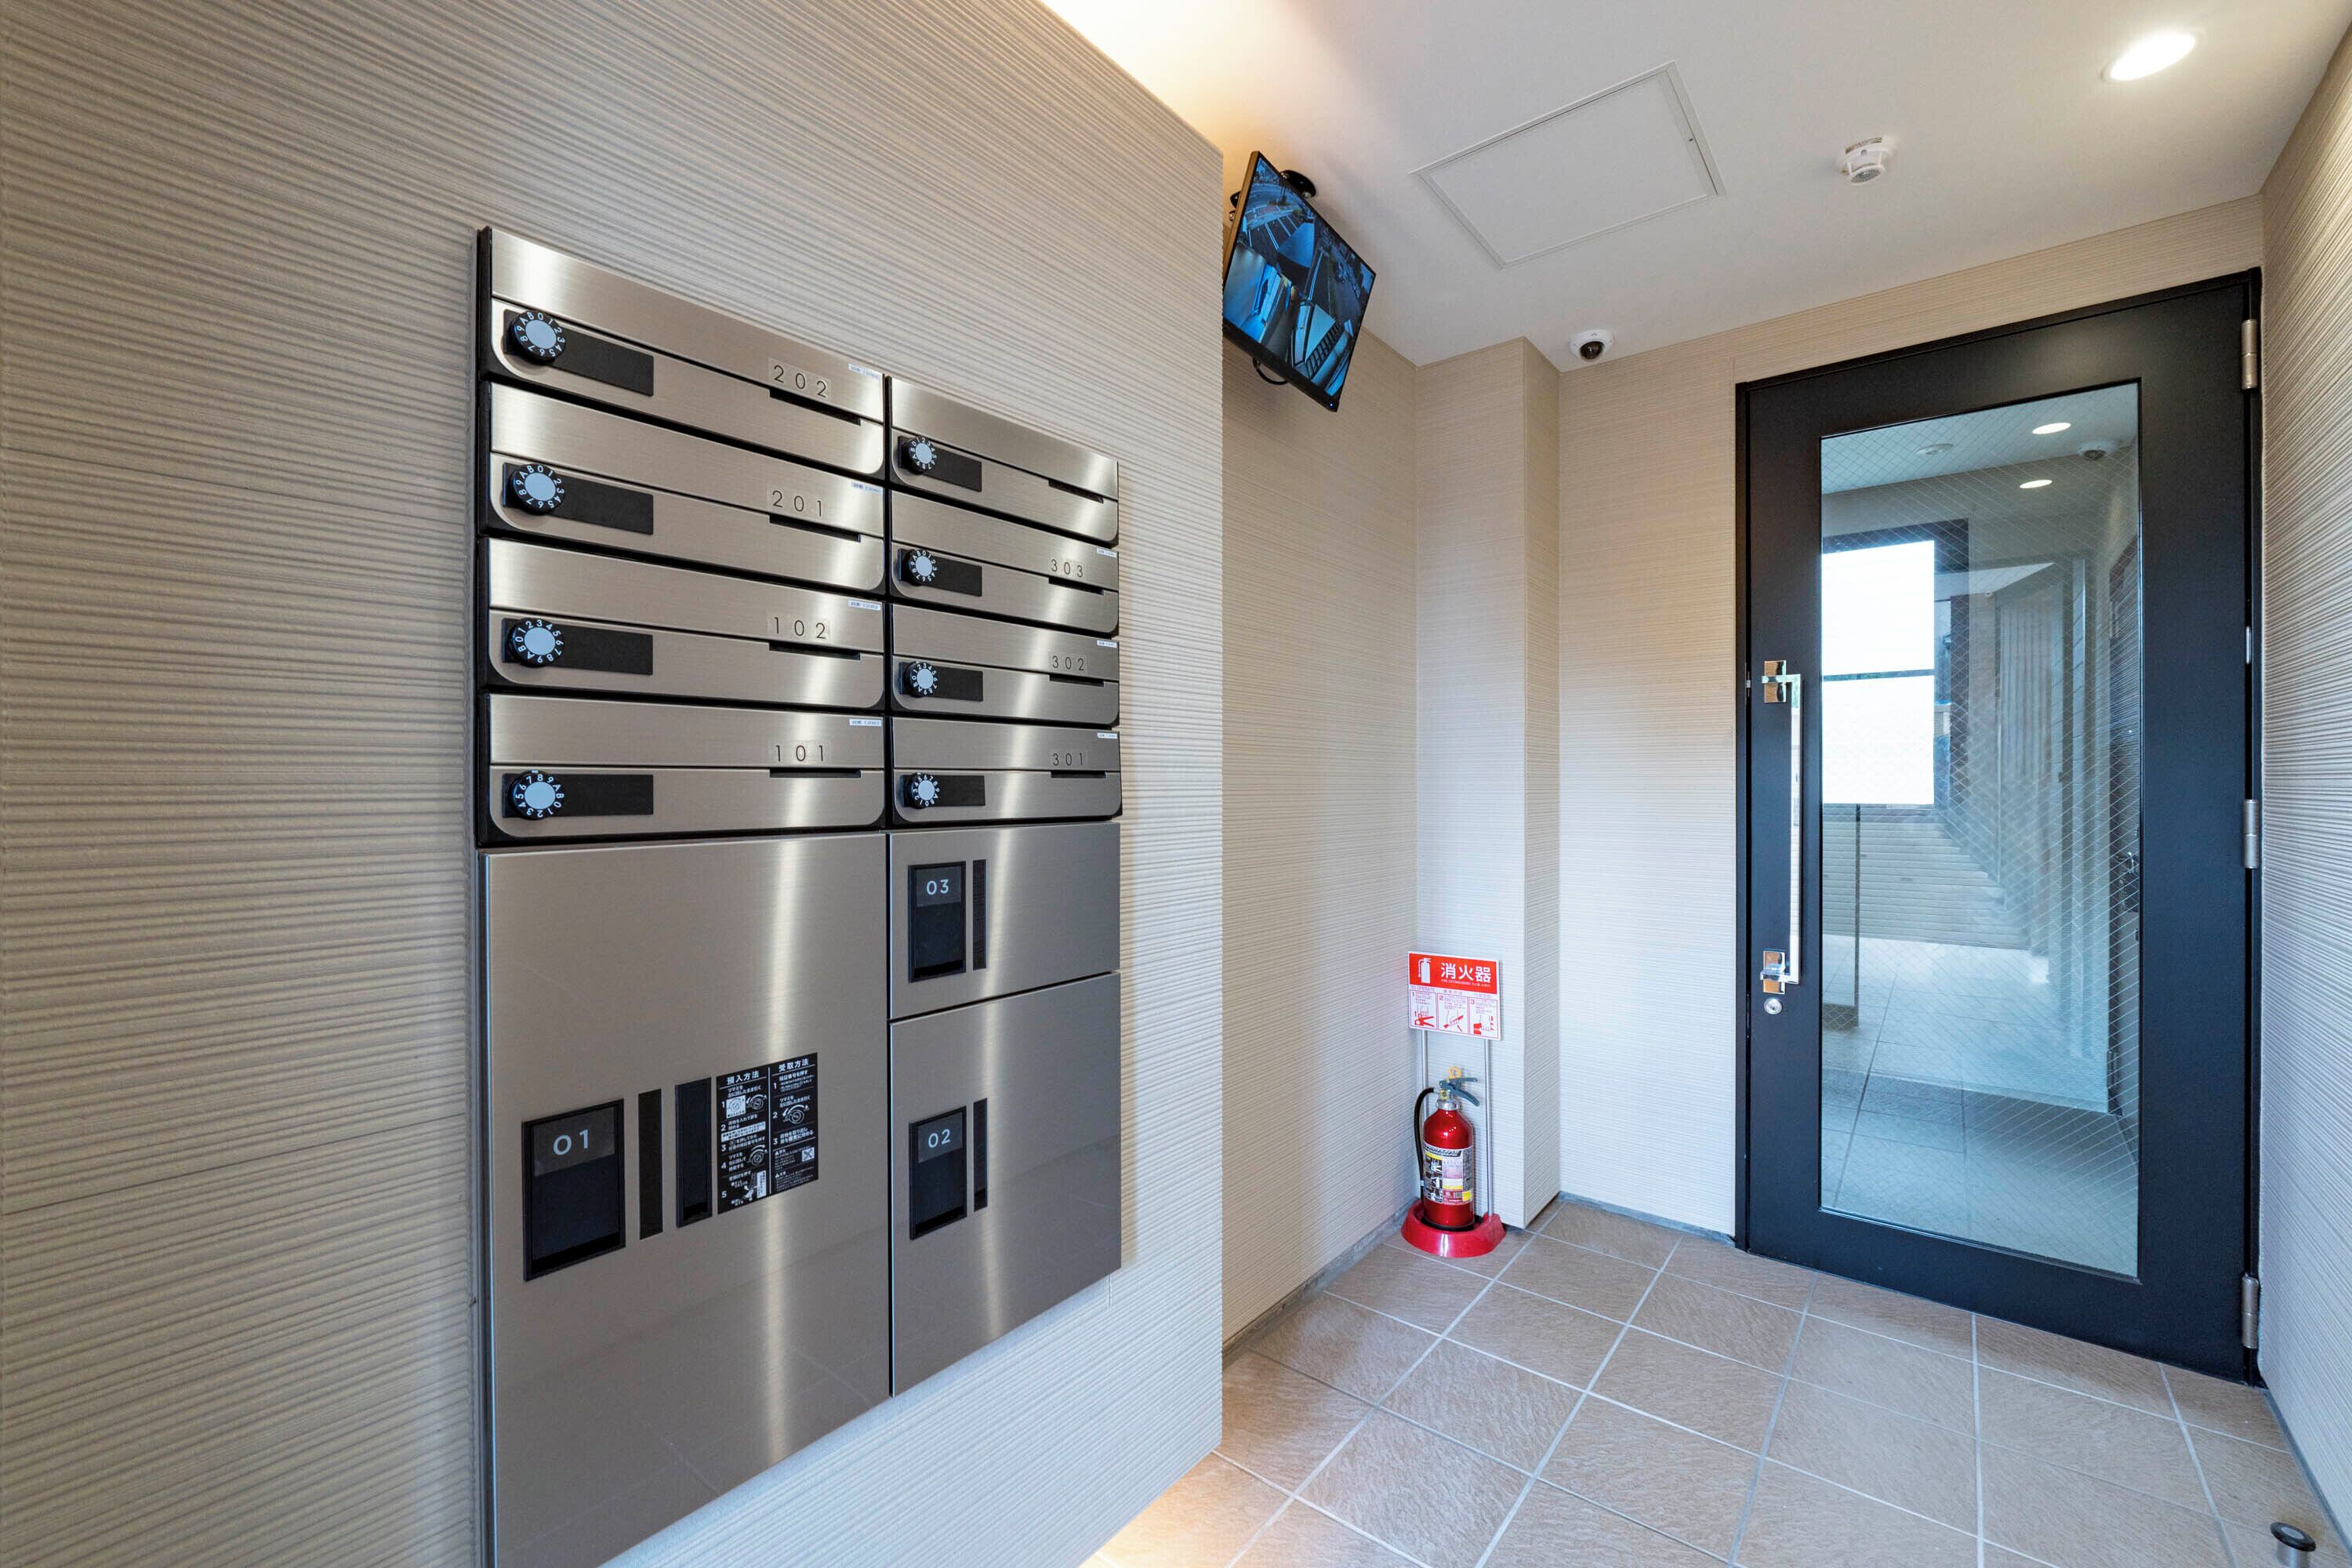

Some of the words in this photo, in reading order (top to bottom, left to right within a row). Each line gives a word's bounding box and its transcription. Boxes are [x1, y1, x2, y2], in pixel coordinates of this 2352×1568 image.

[773, 365, 827, 398] 202
[772, 490, 822, 517] 201
[1051, 558, 1083, 577] 303
[775, 617, 826, 640] 102
[1052, 655, 1084, 671] 302
[775, 745, 823, 762] 101
[1052, 753, 1083, 767] 301
[927, 879, 949, 895] 03
[1441, 962, 1491, 983] 消火器
[778, 1058, 809, 1073] 受取方法
[727, 1070, 760, 1084] 預入方法
[553, 1127, 590, 1156] 01
[928, 1129, 951, 1148] 02
